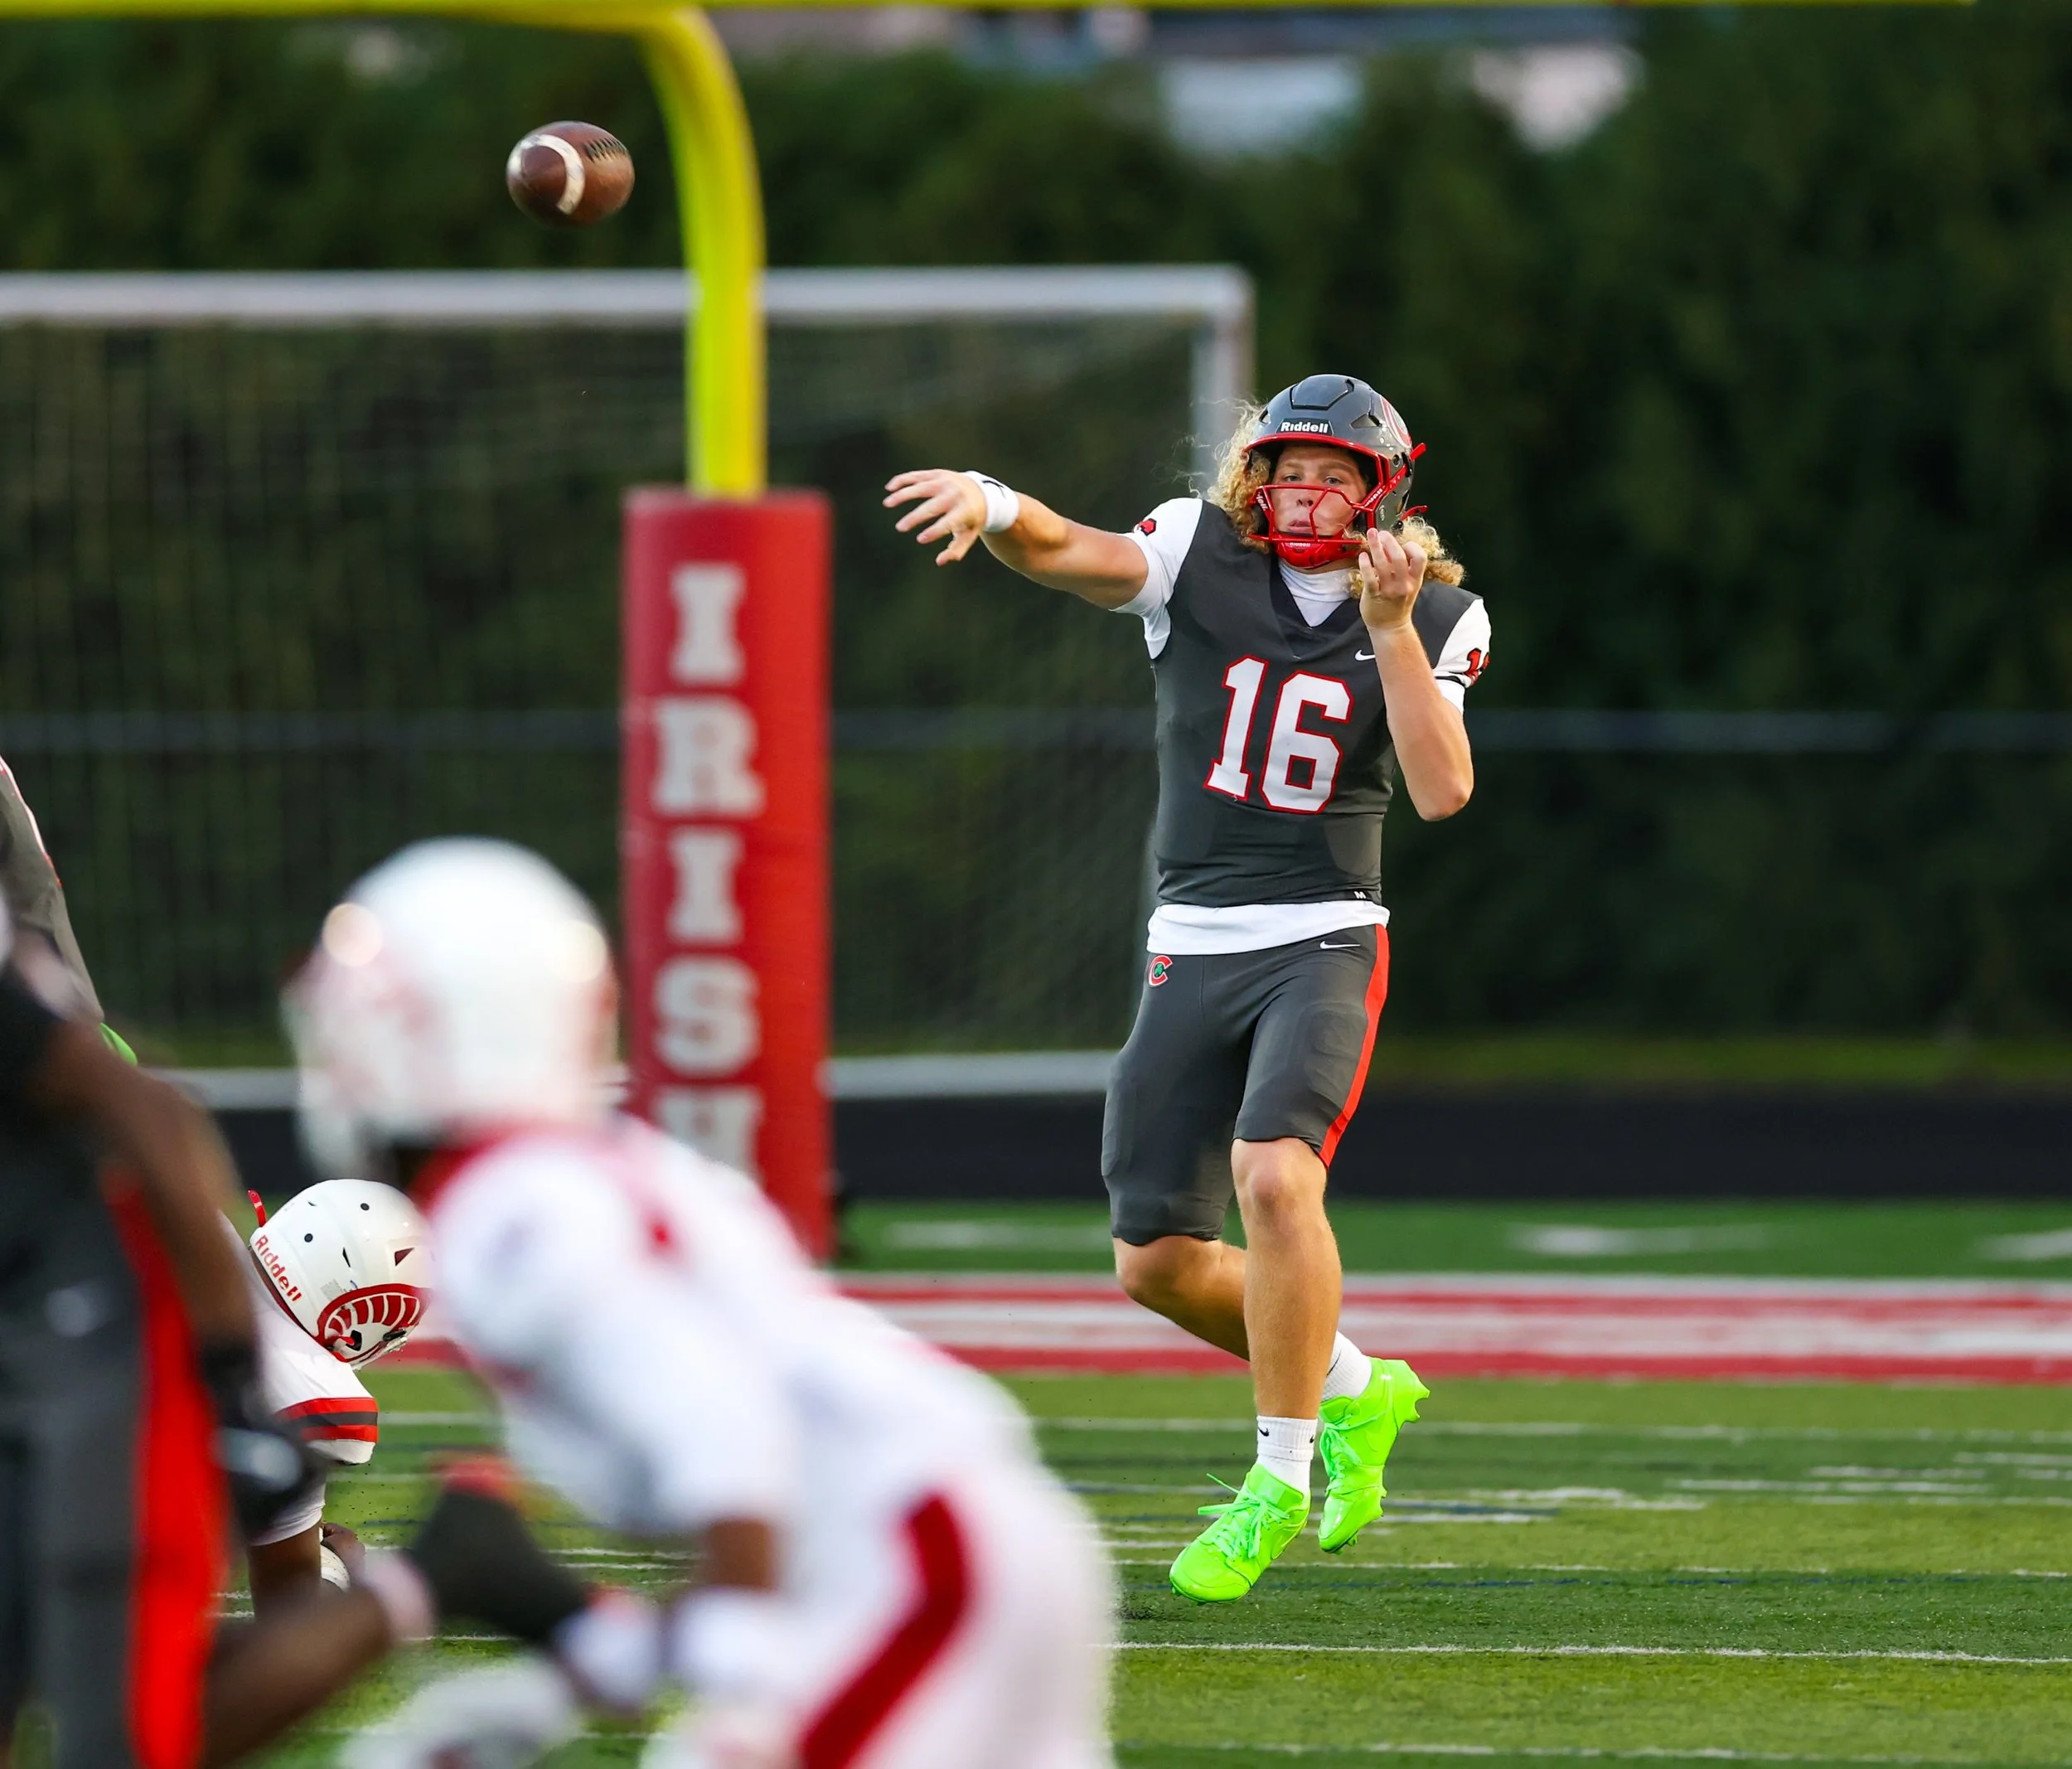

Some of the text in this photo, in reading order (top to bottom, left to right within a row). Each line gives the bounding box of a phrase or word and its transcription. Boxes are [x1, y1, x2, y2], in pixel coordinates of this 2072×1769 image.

[1280, 421, 1329, 434] Riddell
[1466, 647, 1491, 686] 1
[1204, 654, 1354, 815] 16
[255, 1234, 303, 1301] Riddell
